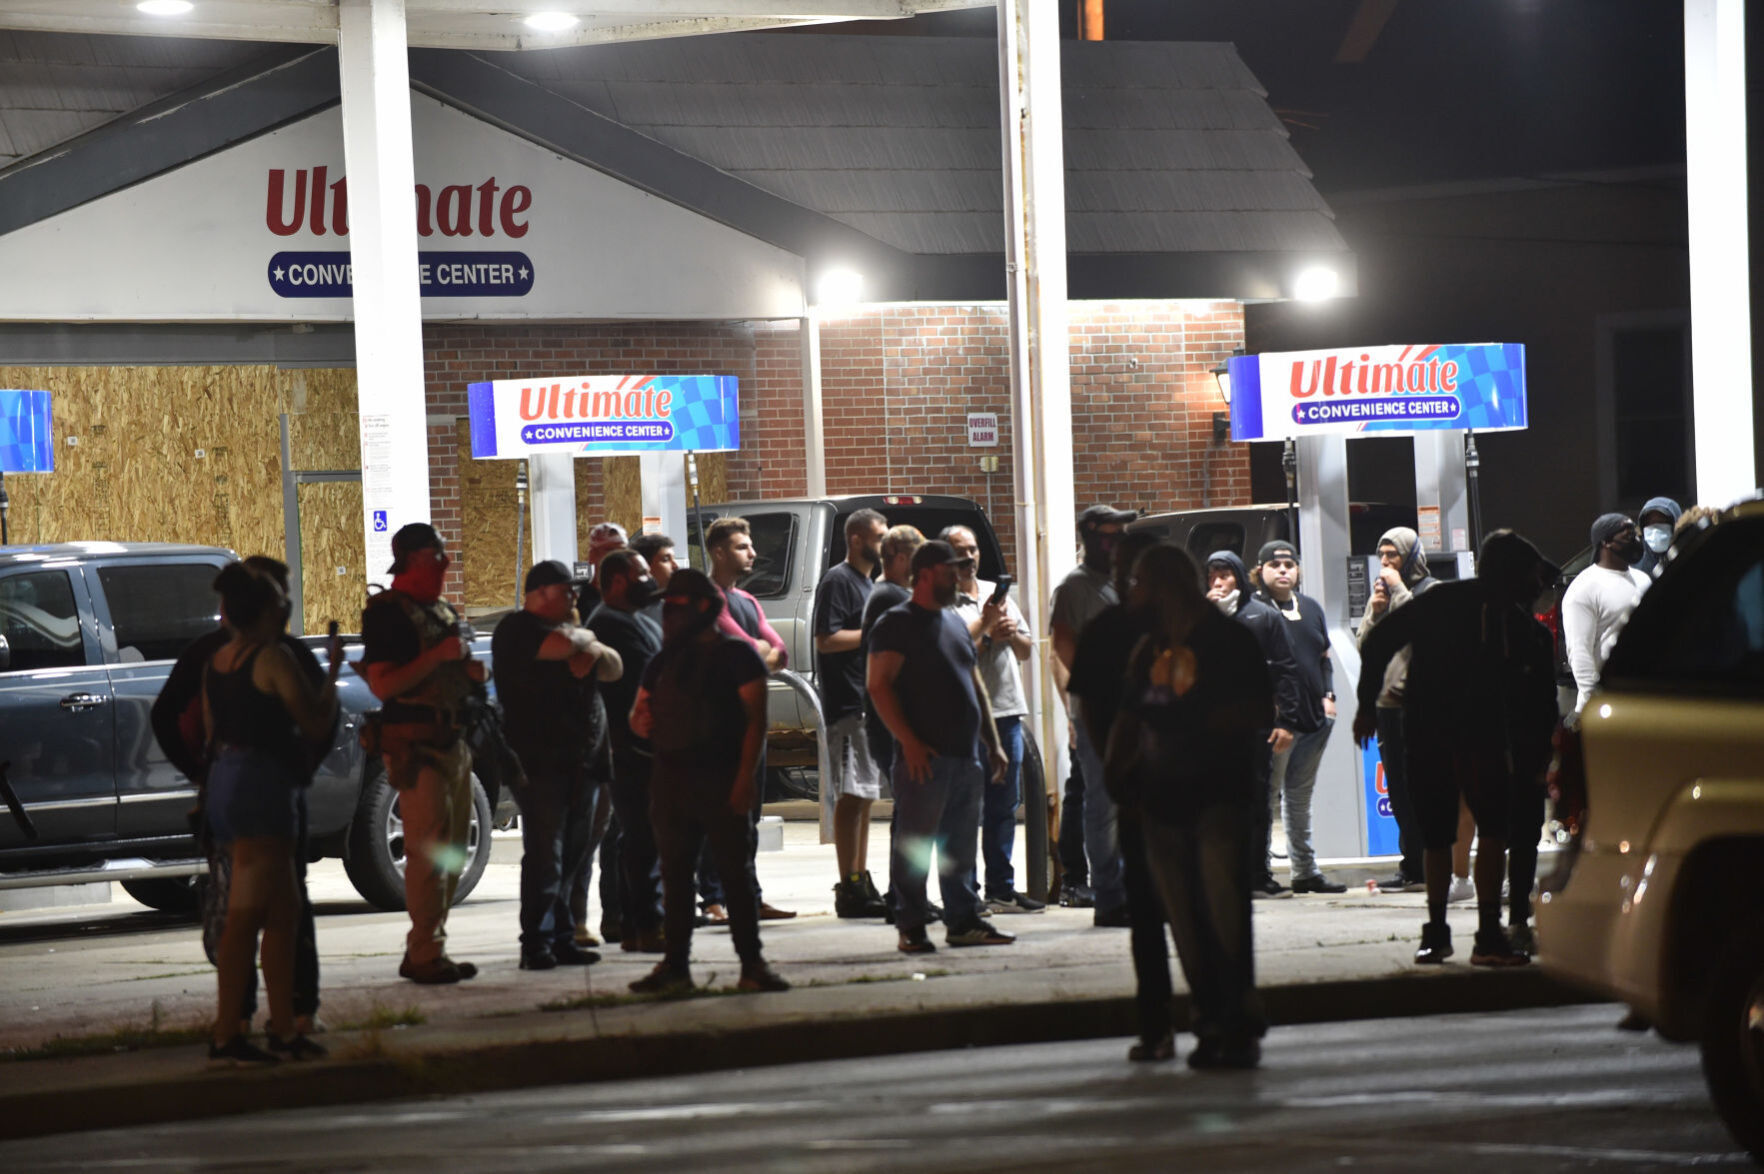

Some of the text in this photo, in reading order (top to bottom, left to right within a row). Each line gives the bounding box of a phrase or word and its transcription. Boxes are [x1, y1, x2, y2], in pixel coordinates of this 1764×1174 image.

[266, 166, 532, 239] Ultate
[437, 263, 515, 285] CENTER
[1290, 354, 1458, 398] Ultimate
[519, 382, 671, 421] Ultimate
[1308, 401, 1449, 419] CONVENIENCE CENTER
[535, 424, 663, 439] CONVENIENCE CENTER
[969, 418, 996, 427] OVERFILL
[973, 432, 994, 441] ALARM
